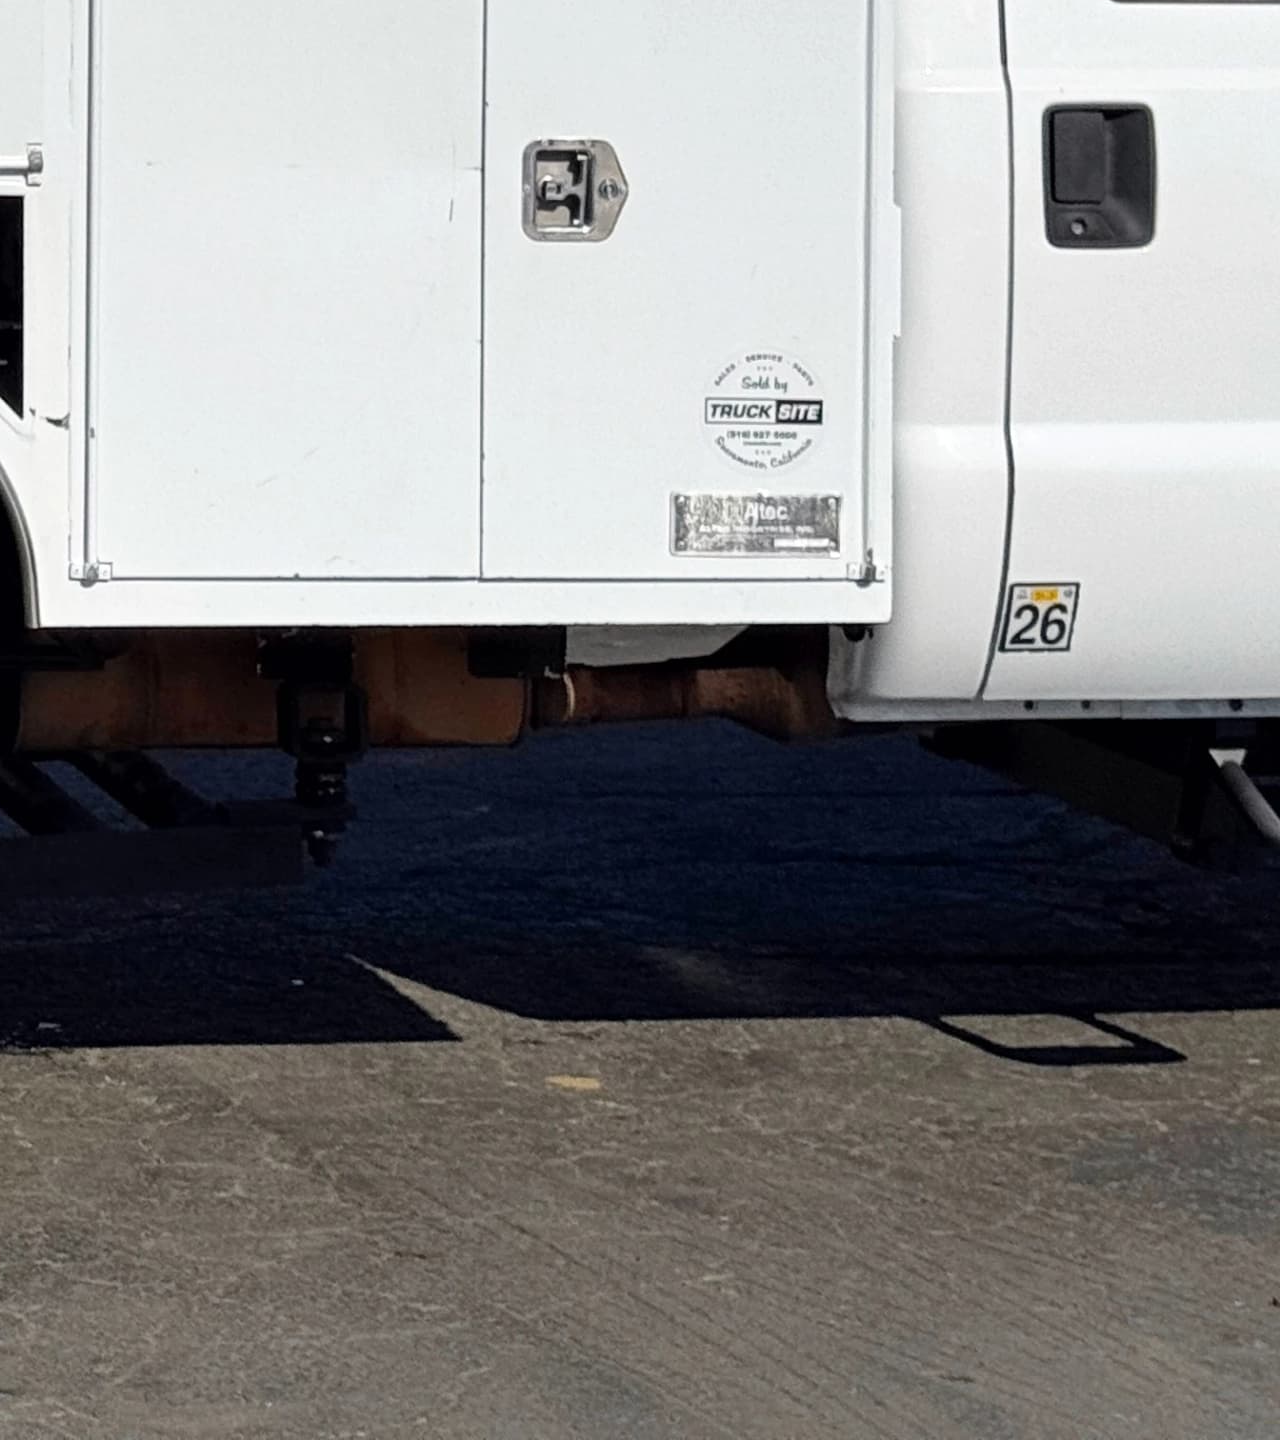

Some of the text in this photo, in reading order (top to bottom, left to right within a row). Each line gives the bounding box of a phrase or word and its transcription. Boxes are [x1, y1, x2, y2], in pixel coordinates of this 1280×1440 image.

[741, 375, 788, 393] Sold by
[711, 404, 820, 420] TRUCK SITE
[1009, 603, 1068, 645] 26
